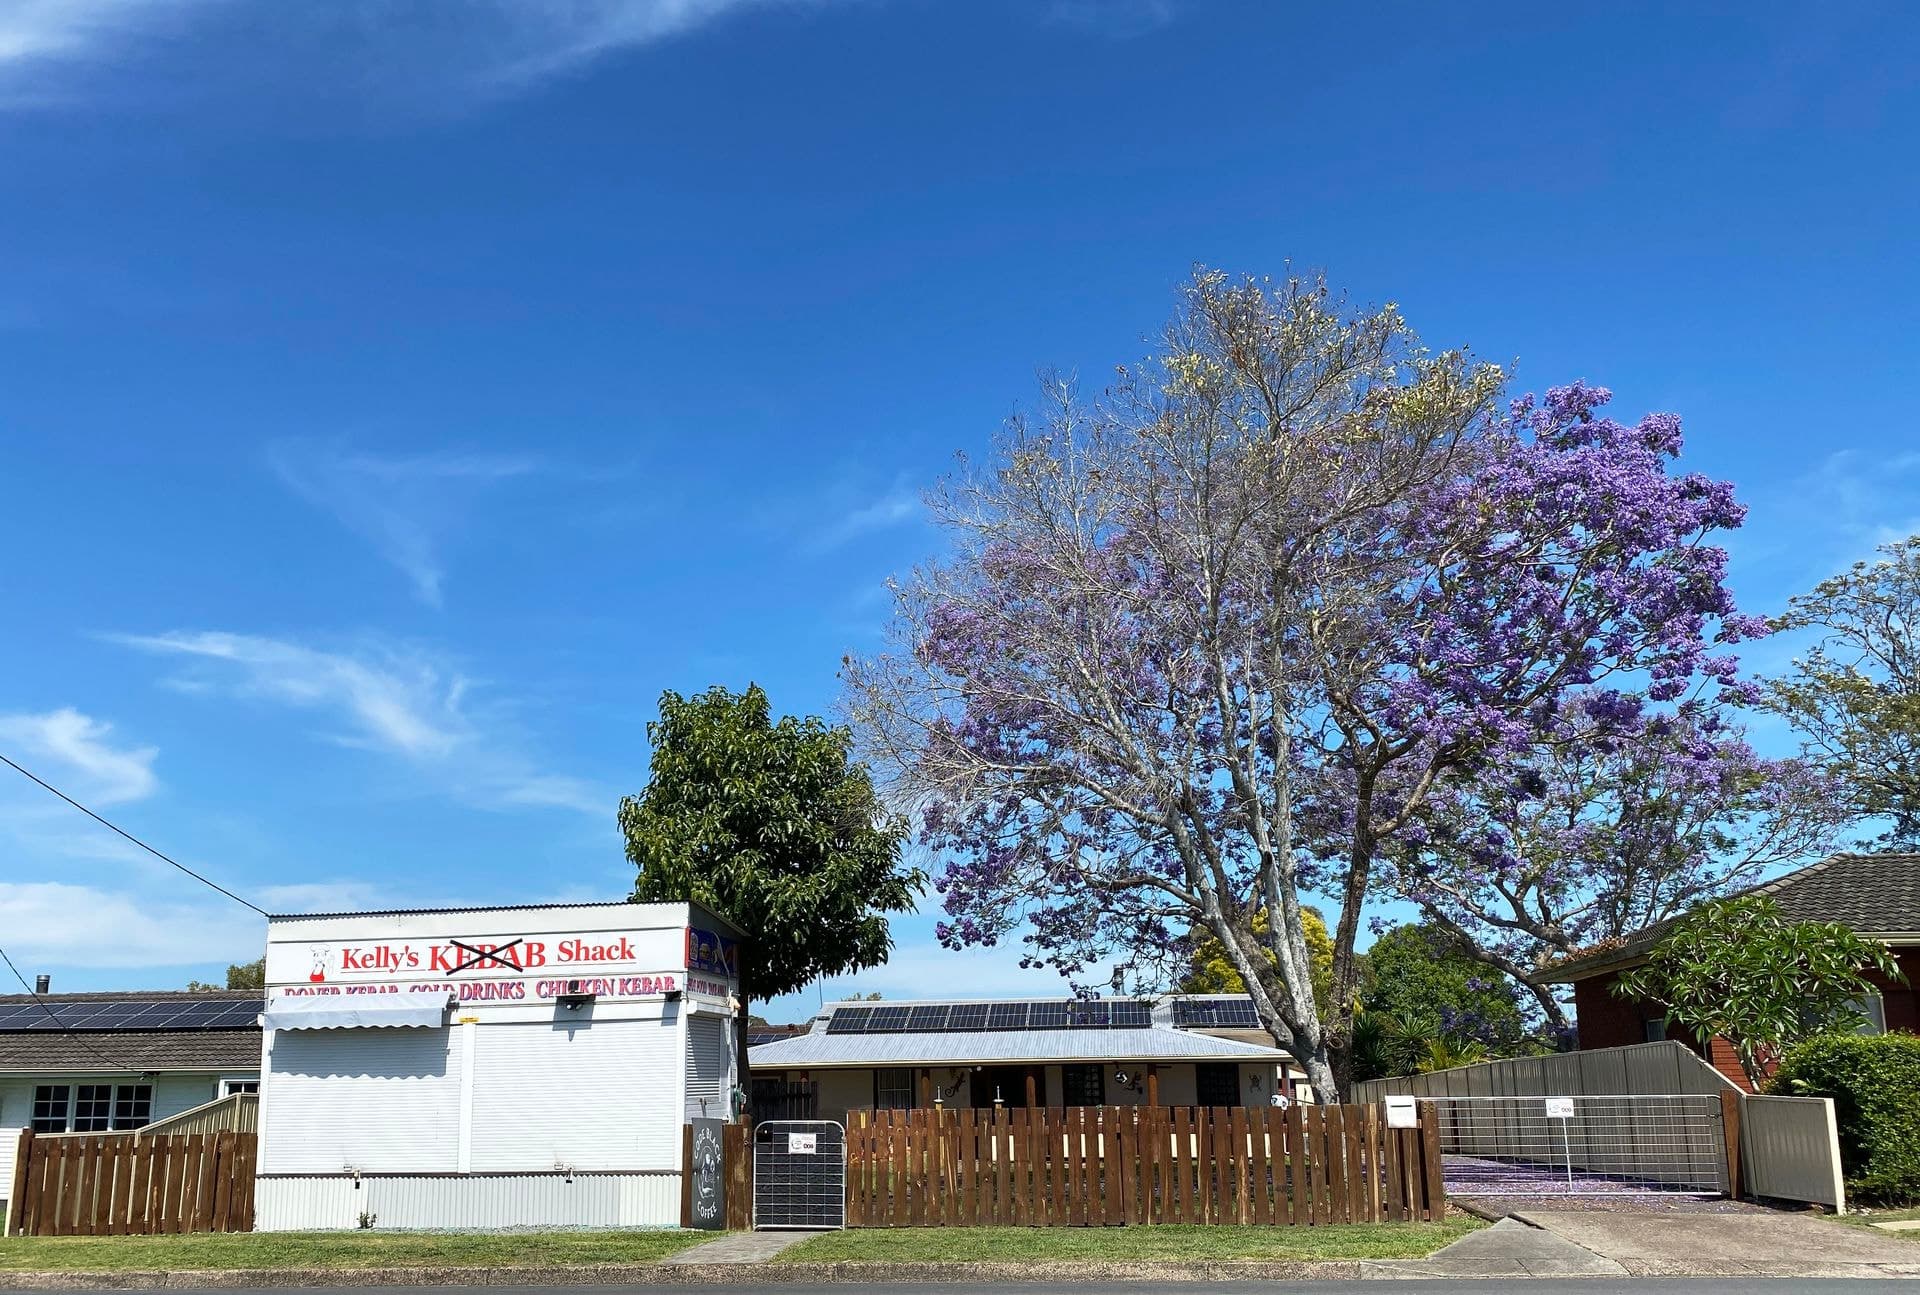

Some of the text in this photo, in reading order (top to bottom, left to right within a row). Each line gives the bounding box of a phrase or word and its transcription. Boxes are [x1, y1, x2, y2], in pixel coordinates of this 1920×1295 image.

[341, 937, 637, 973] Kelly's KEBAB Shack
[459, 980, 526, 1001] DRINKS
[535, 978, 615, 999] CHIKEN
[618, 976, 675, 996] KEBAB
[706, 1127, 721, 1164] BLACK
[697, 1200, 717, 1219] COFFEE
